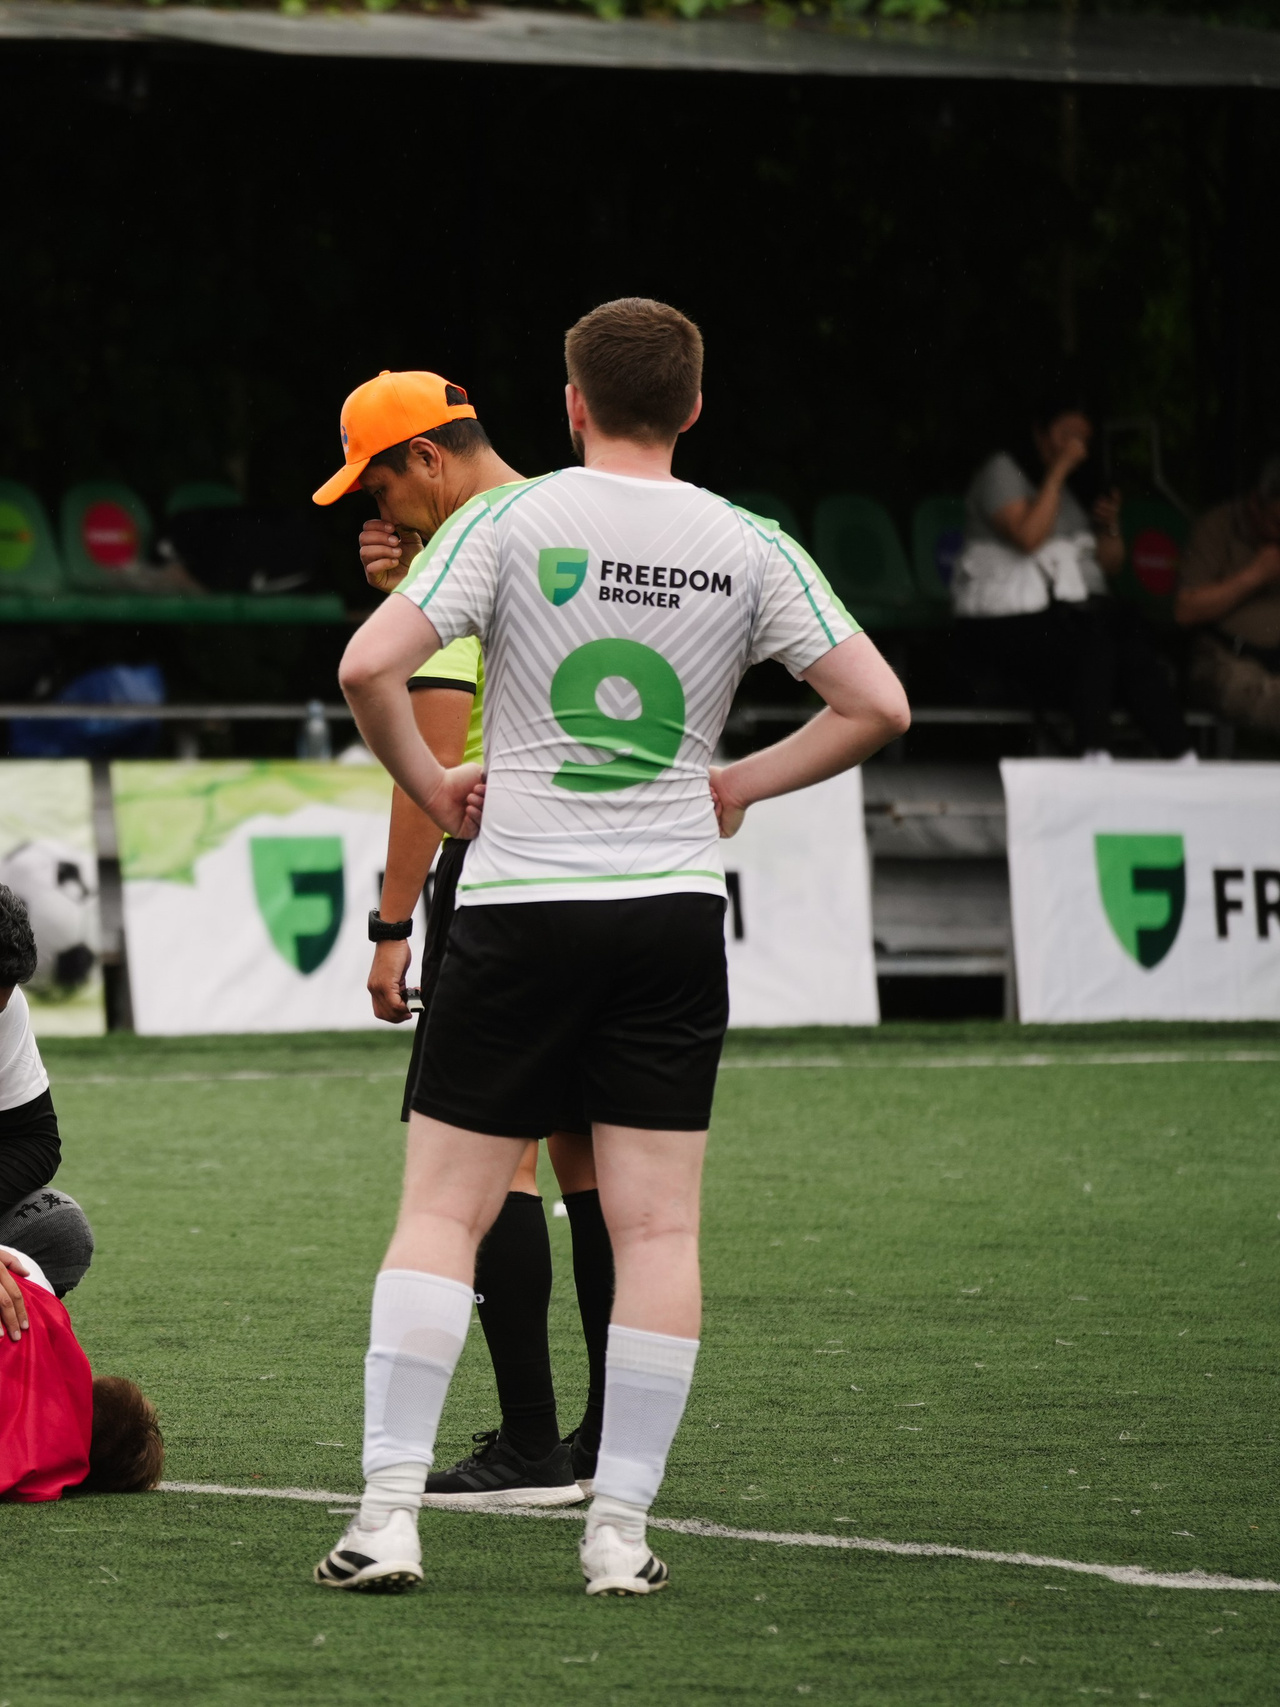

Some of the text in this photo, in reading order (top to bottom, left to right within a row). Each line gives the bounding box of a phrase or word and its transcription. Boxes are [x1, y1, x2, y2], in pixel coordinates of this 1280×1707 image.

[601, 560, 732, 597] FREEDOM
[599, 586, 681, 609] BROKER
[550, 638, 686, 793] 9
